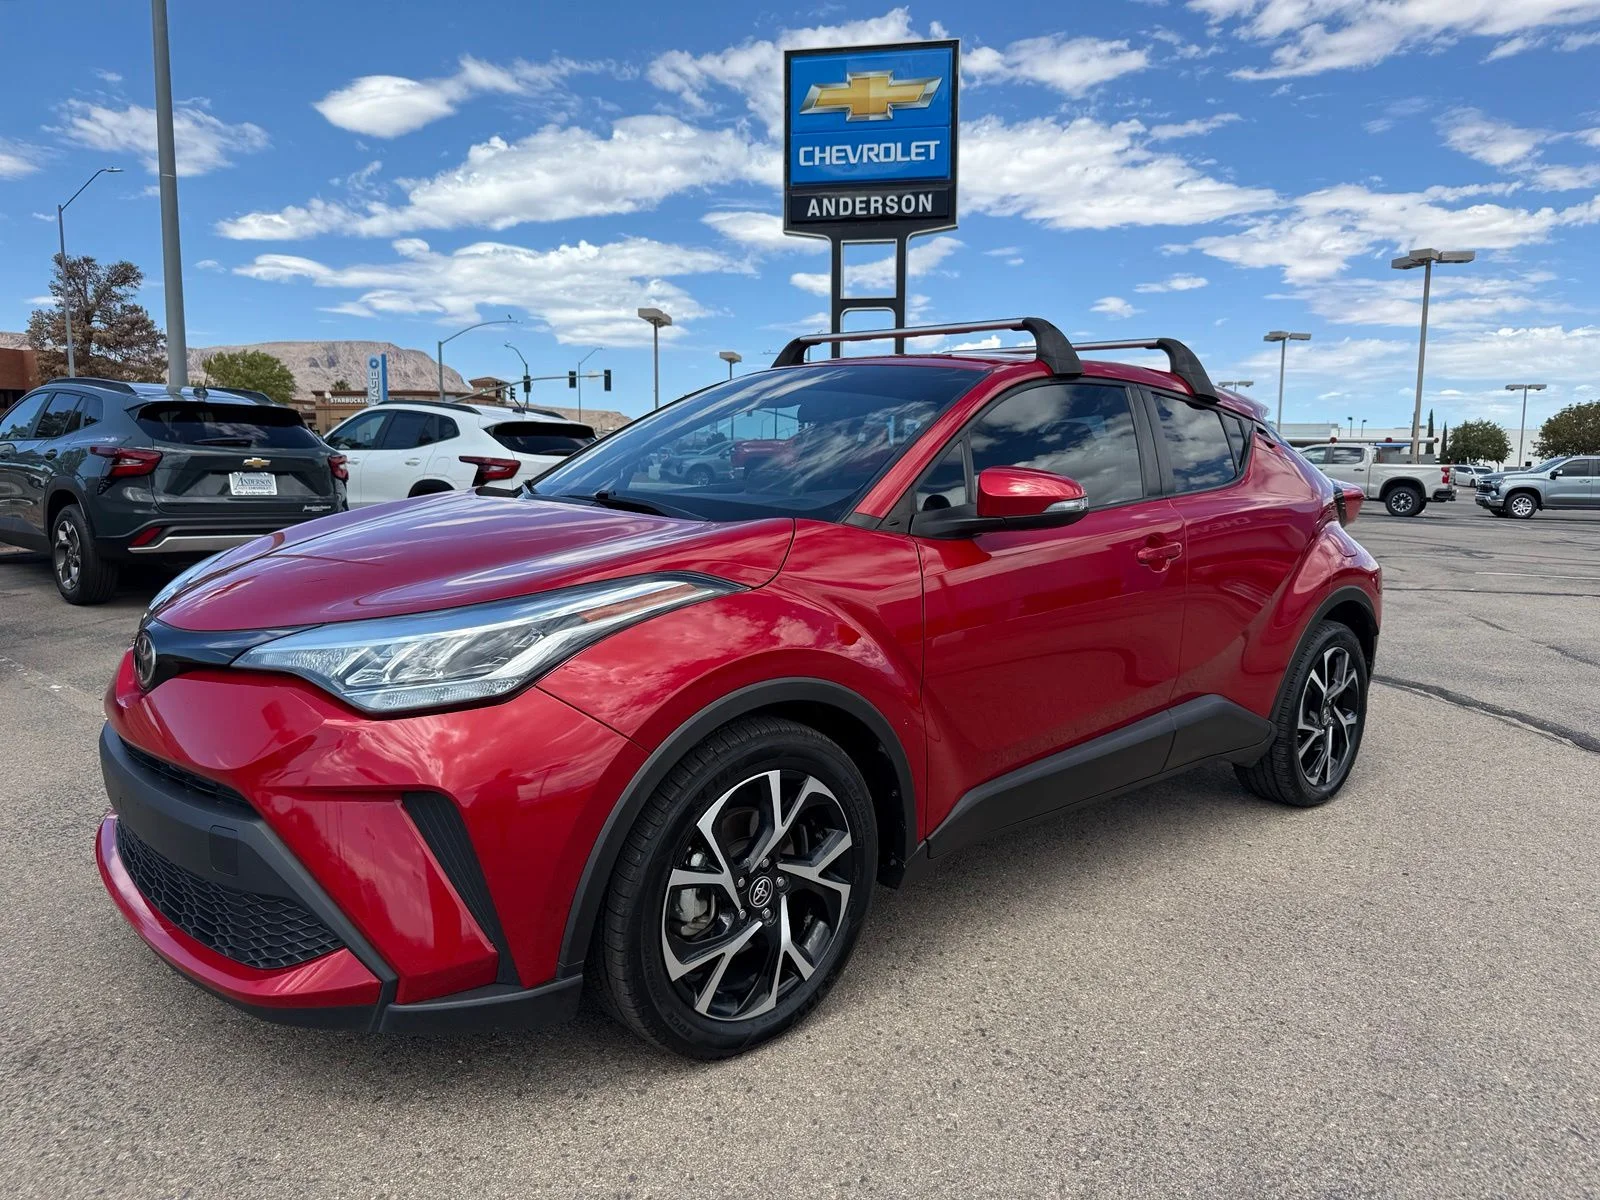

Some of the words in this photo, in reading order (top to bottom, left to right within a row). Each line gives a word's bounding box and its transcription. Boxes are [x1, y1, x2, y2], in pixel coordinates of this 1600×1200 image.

[799, 140, 940, 166] CHEVROLET
[807, 194, 933, 217] ANDERSON
[370, 370, 380, 406] HASE
[237, 477, 272, 486] ANDERSON
